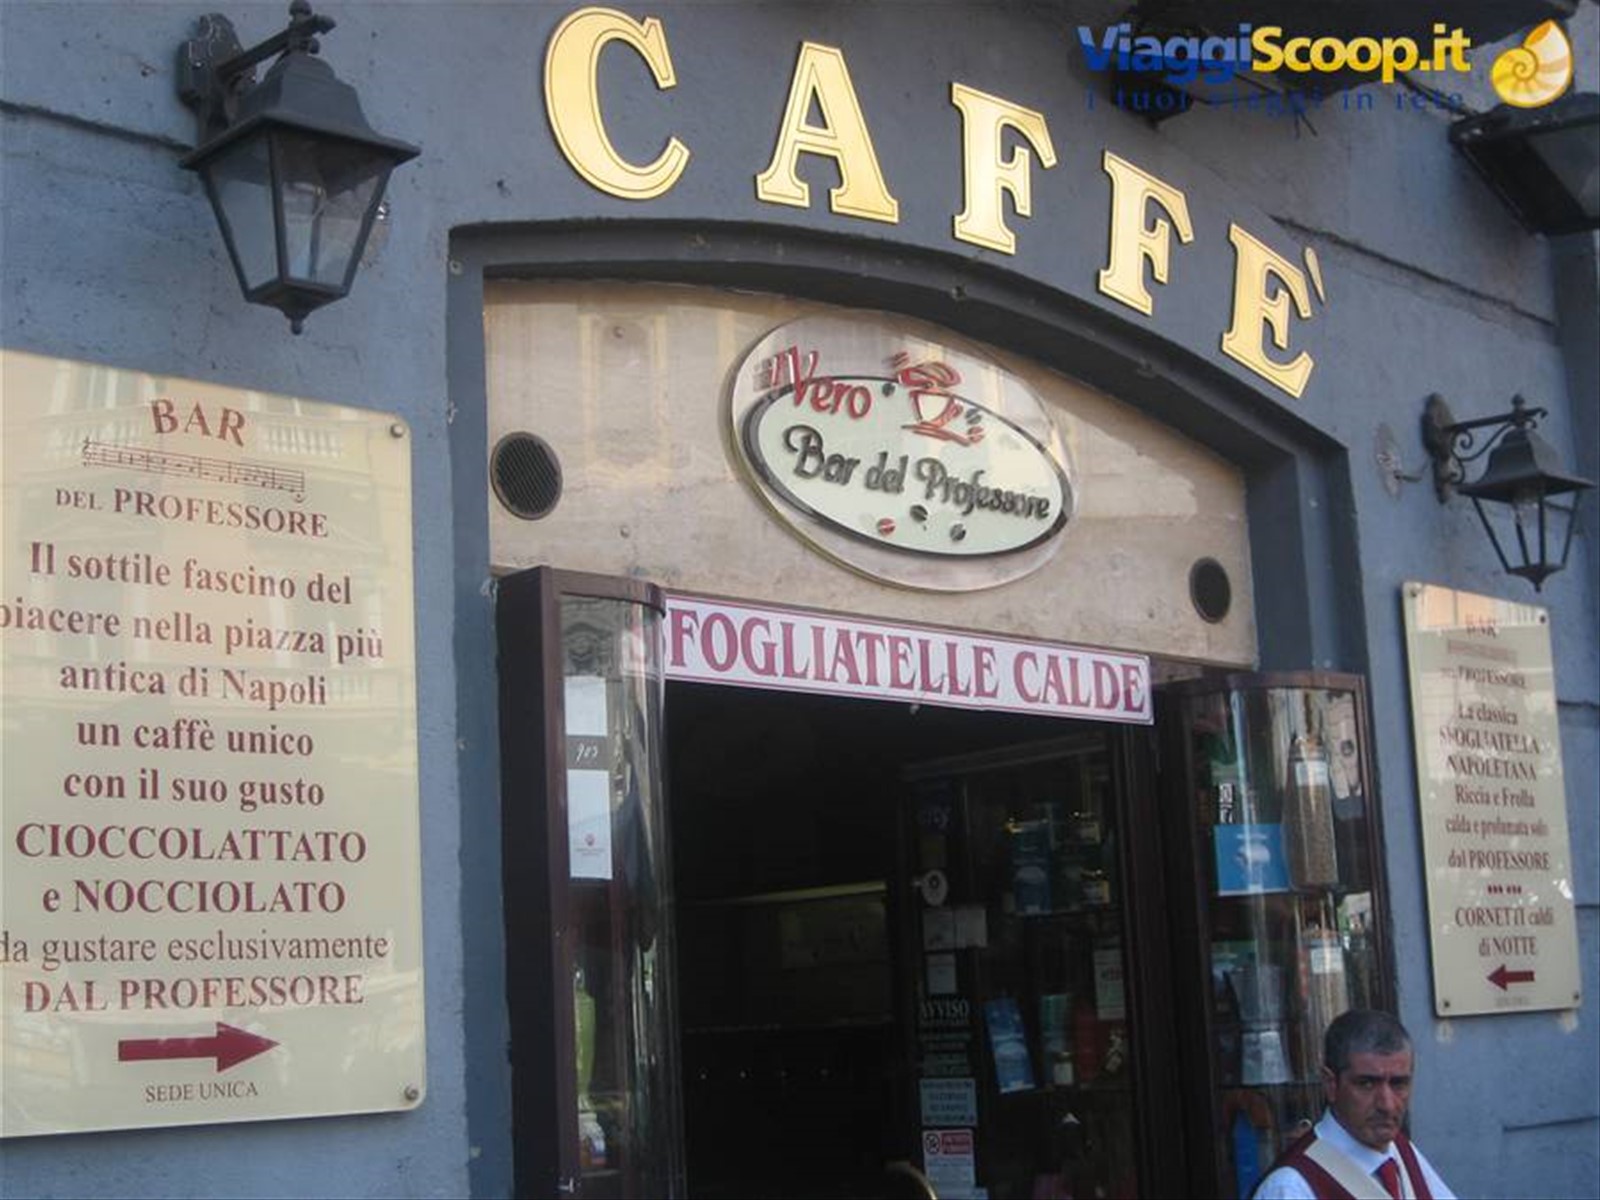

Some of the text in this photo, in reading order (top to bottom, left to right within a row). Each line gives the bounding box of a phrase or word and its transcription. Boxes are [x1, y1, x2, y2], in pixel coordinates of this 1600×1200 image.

[788, 346, 872, 420] Vero
[151, 398, 247, 447] BAR
[783, 424, 1050, 519] Bar del Professore
[56, 488, 329, 538] DEL PROFESSORE
[30, 542, 352, 605] Il sottile fascino del
[133, 612, 212, 645] nella
[225, 619, 325, 656] piazza
[336, 627, 384, 663] più
[662, 606, 1146, 713] FOGLIATELLE CALDE
[60, 661, 327, 712] antica di Napoli
[77, 719, 314, 756] un caffè unico
[1448, 754, 1537, 781] NAPOLETANA
[63, 768, 325, 812] con il suo gusto
[1455, 783, 1490, 805] Riccia
[1502, 787, 1535, 808] Frolla
[16, 823, 367, 864] CIOCCOLATTATO
[1448, 849, 1551, 871] dal PROFESSORE
[42, 879, 346, 914] e NOCCIOLATO
[1455, 907, 1525, 927] CORNETTI
[42, 931, 157, 972] gustare
[168, 929, 390, 962] esclusivamente
[1492, 936, 1538, 956] NOTTE
[24, 975, 365, 1013] DAL PROFESSORE
[145, 1081, 259, 1103] SEDE UNICA
